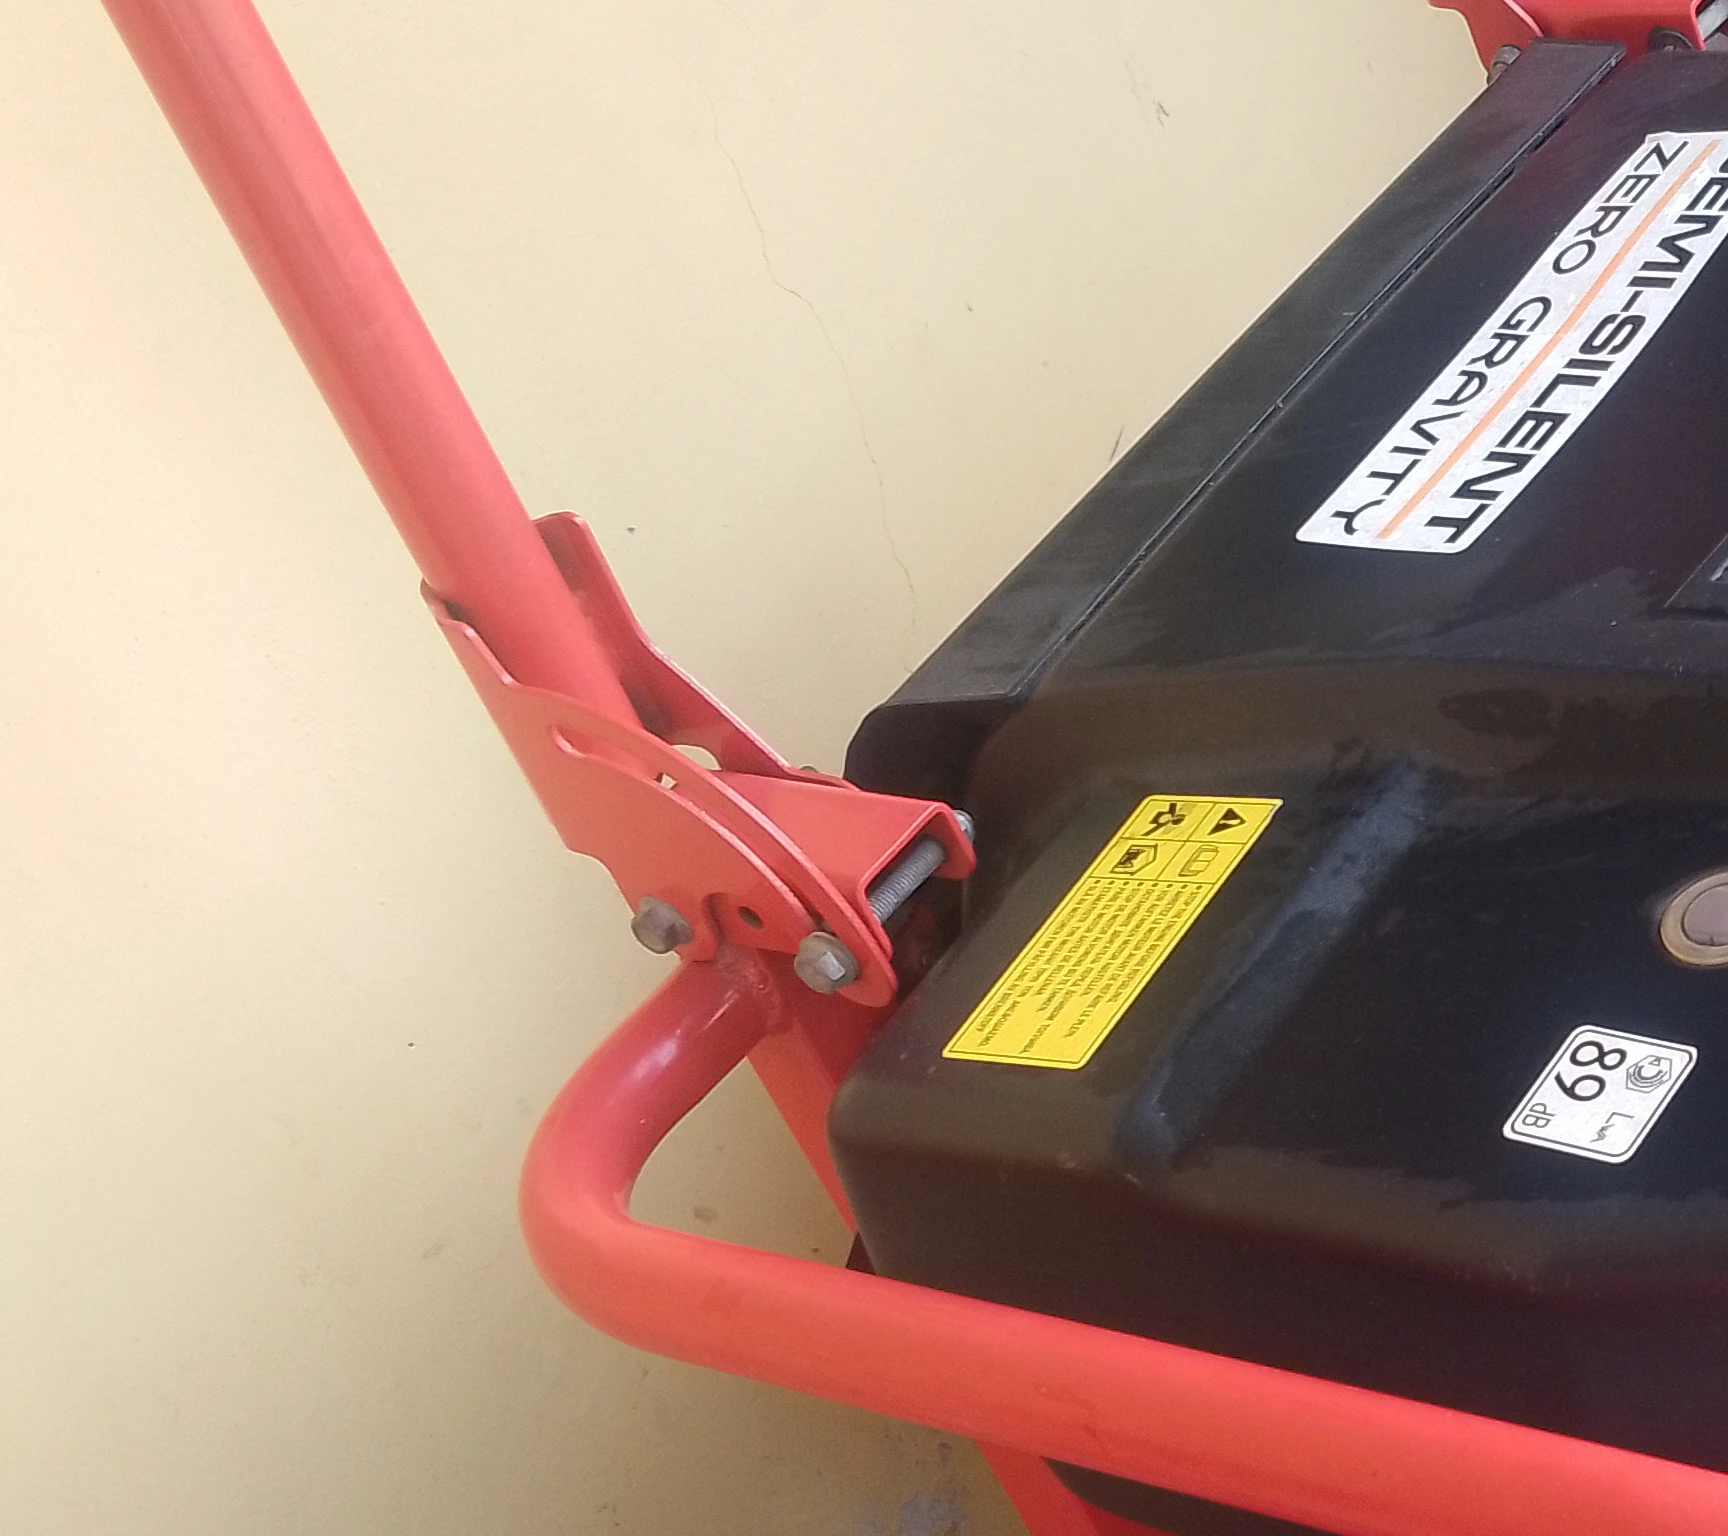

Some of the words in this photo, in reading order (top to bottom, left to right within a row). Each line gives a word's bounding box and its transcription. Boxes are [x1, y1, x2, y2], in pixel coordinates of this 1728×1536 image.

[1551, 139, 1690, 276] ZERO
[1330, 296, 1552, 537] GRAVITY
[1521, 1102, 1557, 1129] dB
[1554, 1040, 1628, 1102] 89
